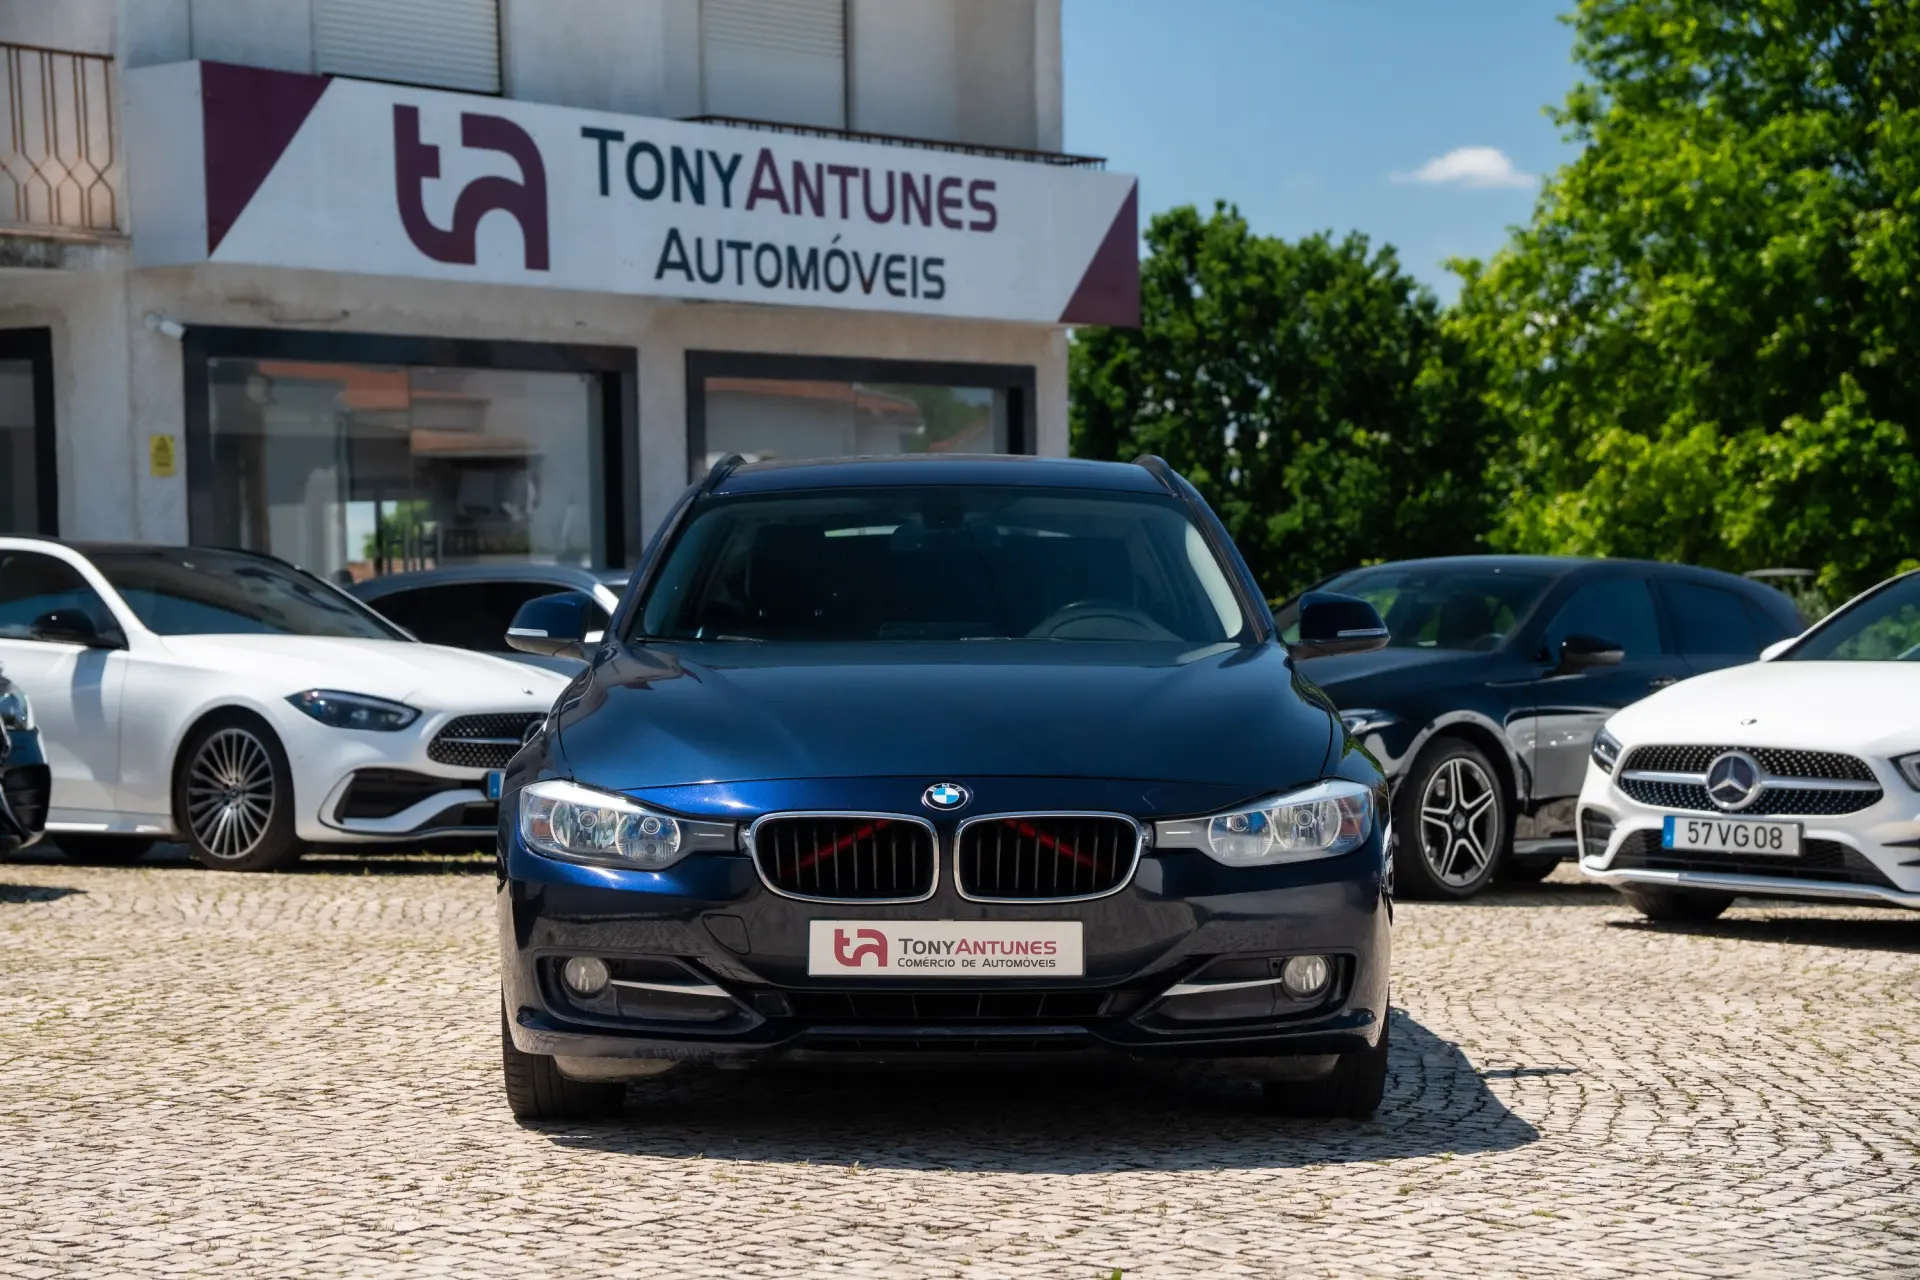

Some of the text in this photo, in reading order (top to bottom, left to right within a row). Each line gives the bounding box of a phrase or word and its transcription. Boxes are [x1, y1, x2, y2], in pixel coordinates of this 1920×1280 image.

[654, 227, 946, 300] AUTOMÓVEIS
[897, 956, 1056, 968] COMÉRCIO DE AUTOMÓVEIS
